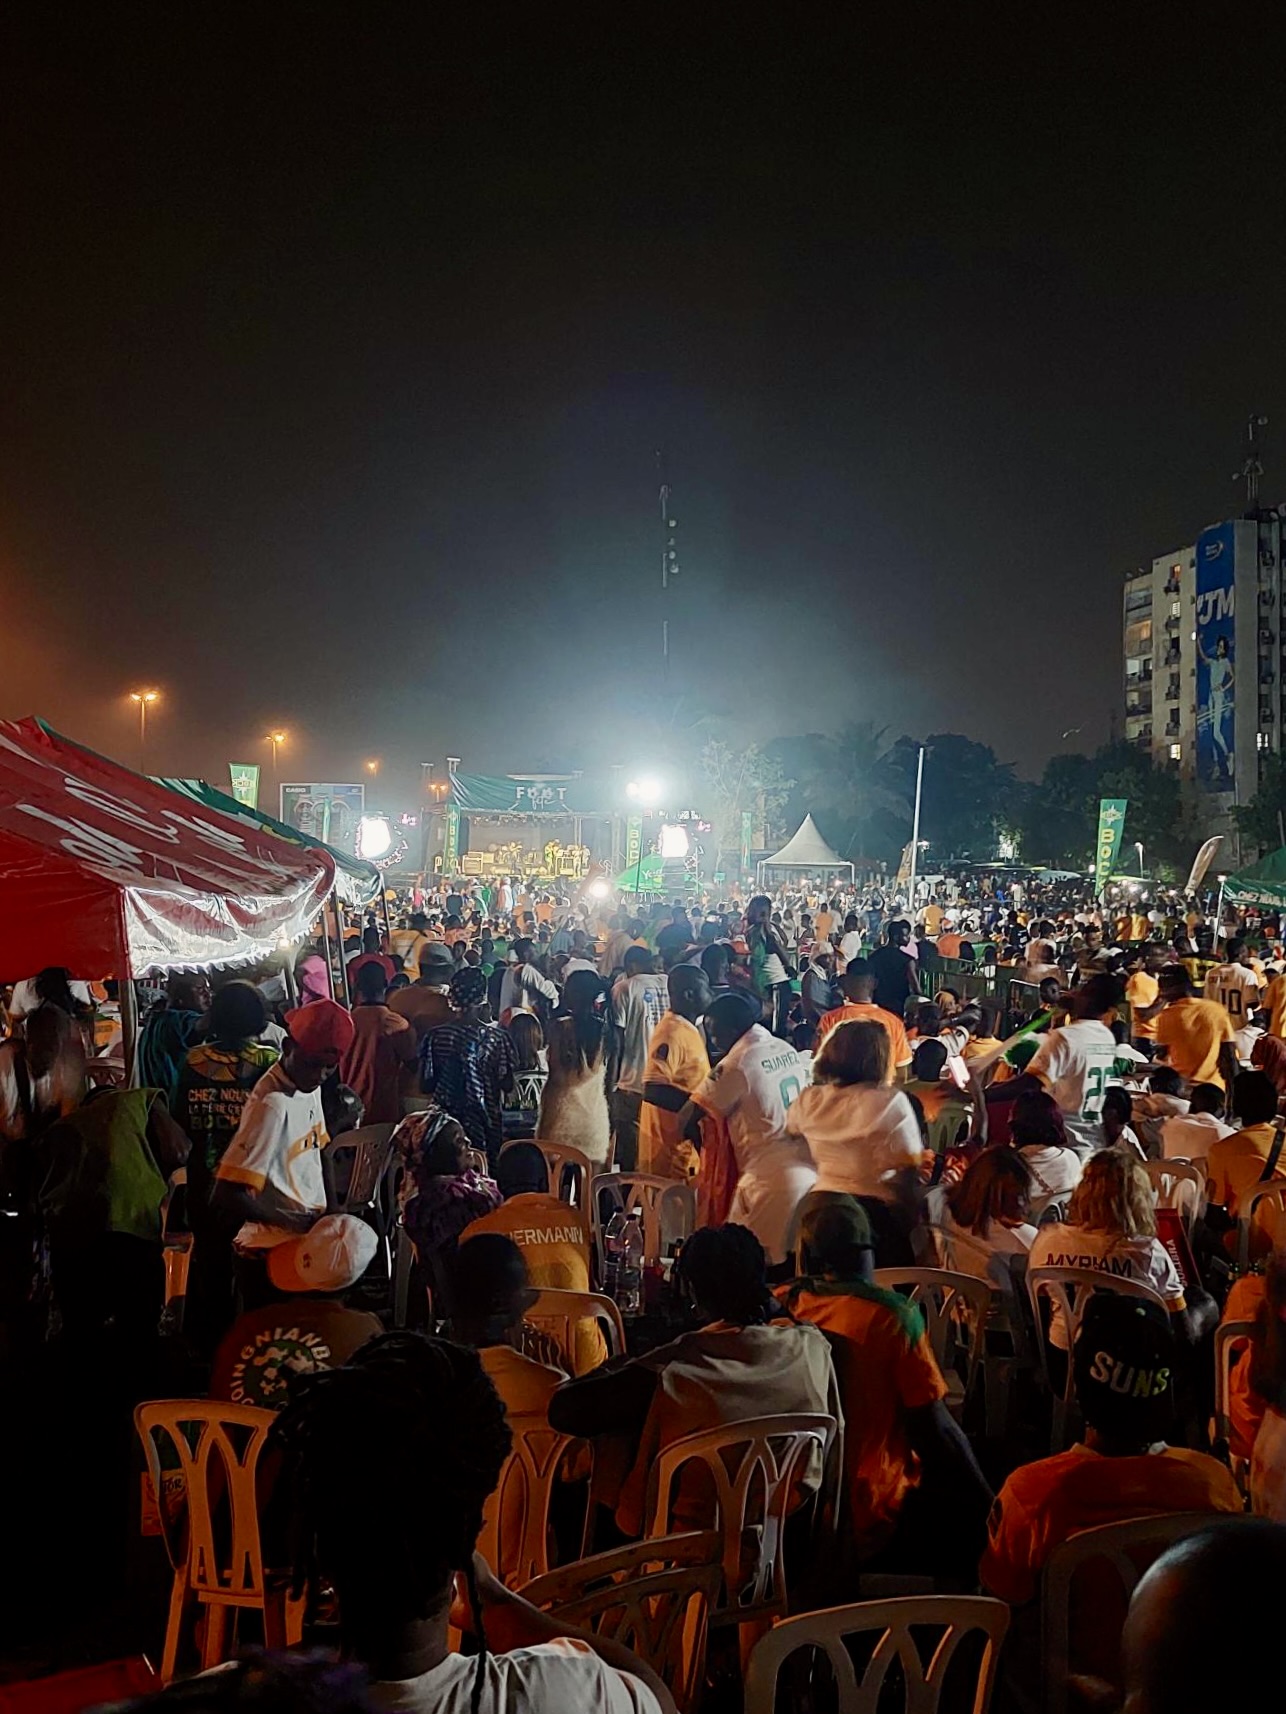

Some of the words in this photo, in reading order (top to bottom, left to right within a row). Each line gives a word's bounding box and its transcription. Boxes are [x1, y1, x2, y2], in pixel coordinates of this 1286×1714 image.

[1221, 988, 1242, 1015] 10
[186, 1087, 218, 1102] CHEZ
[1045, 1253, 1132, 1278] MYRIAM
[1089, 1351, 1170, 1398] SUNS
